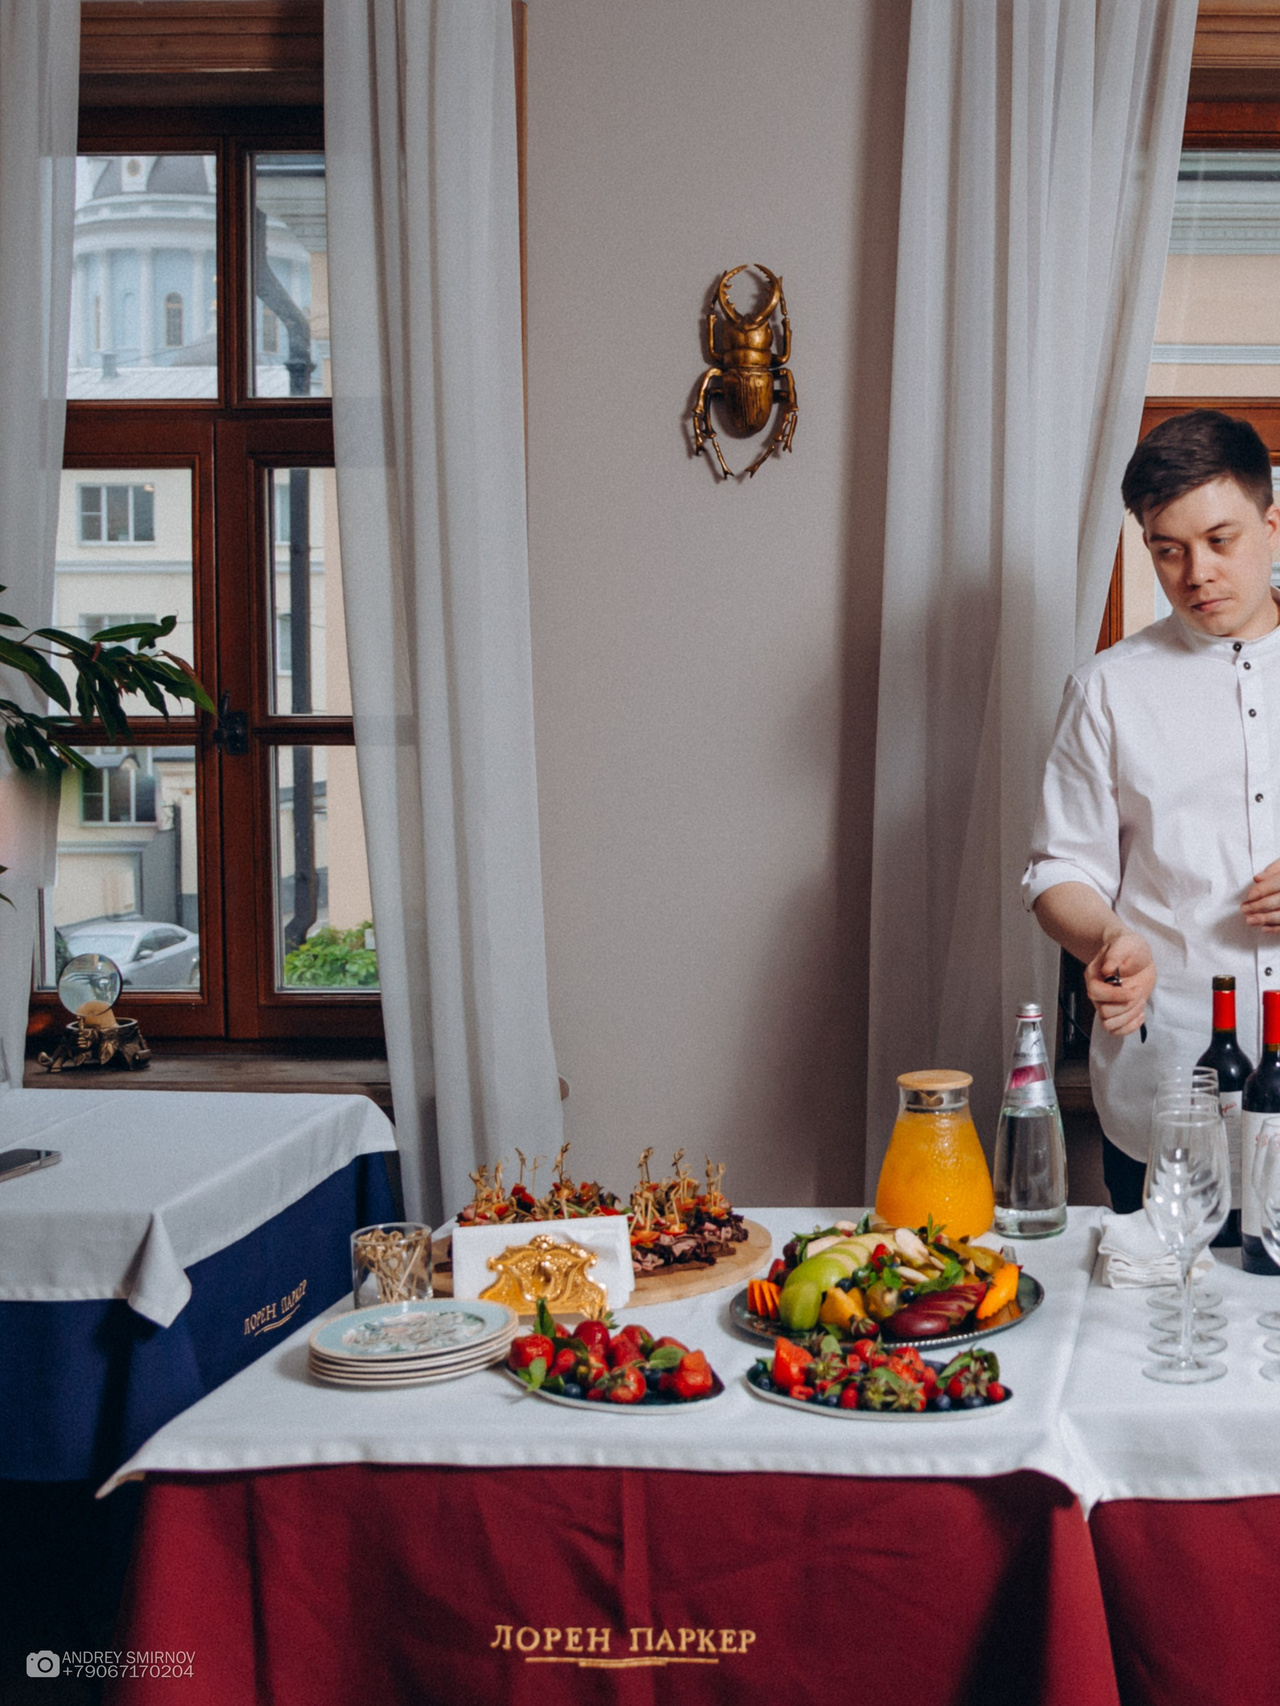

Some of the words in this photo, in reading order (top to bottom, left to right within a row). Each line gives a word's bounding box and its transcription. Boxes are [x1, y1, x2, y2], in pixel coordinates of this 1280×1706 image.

[243, 1302, 277, 1335] ЛОРЕН
[490, 1624, 611, 1652] ЛОРЕН
[629, 1627, 757, 1654] ПАРКЕР
